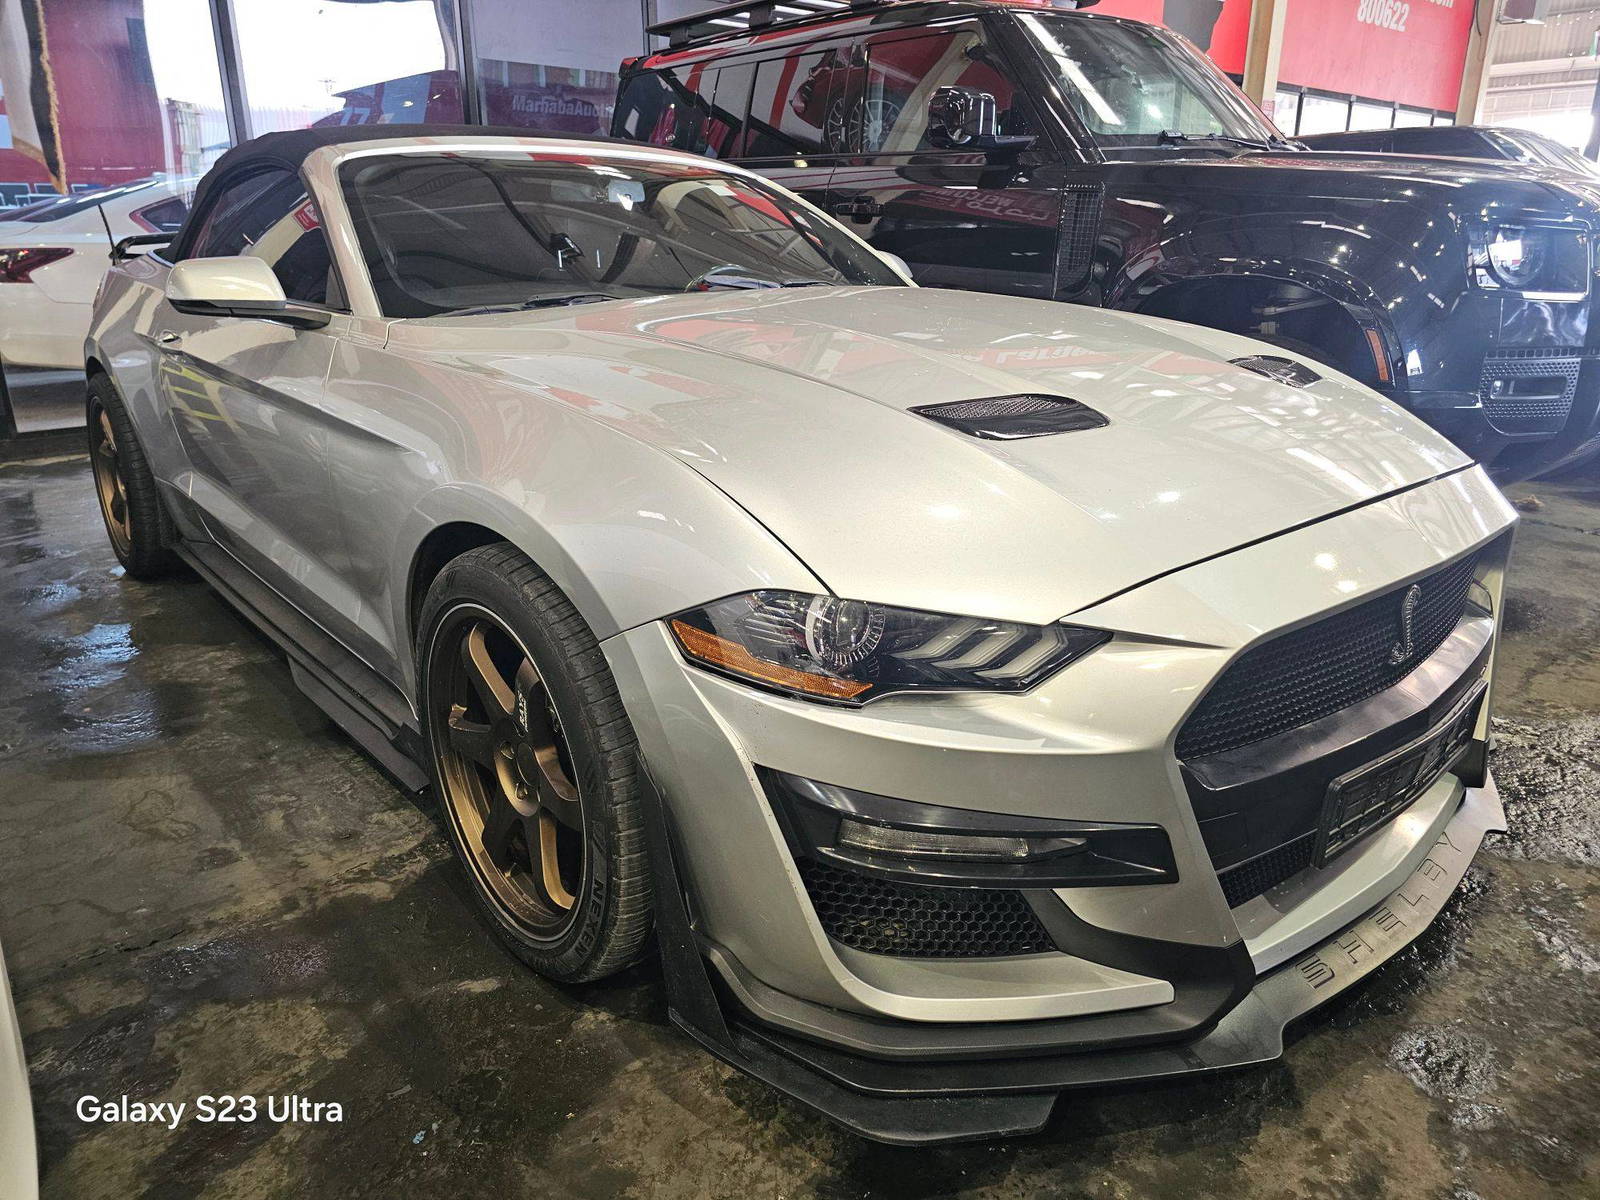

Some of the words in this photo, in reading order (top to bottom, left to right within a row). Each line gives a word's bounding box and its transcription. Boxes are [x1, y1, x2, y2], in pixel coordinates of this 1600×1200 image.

[1356, 0, 1410, 32] 800622
[576, 879, 604, 955] NEXEN
[1296, 831, 1462, 990] SHELBY
